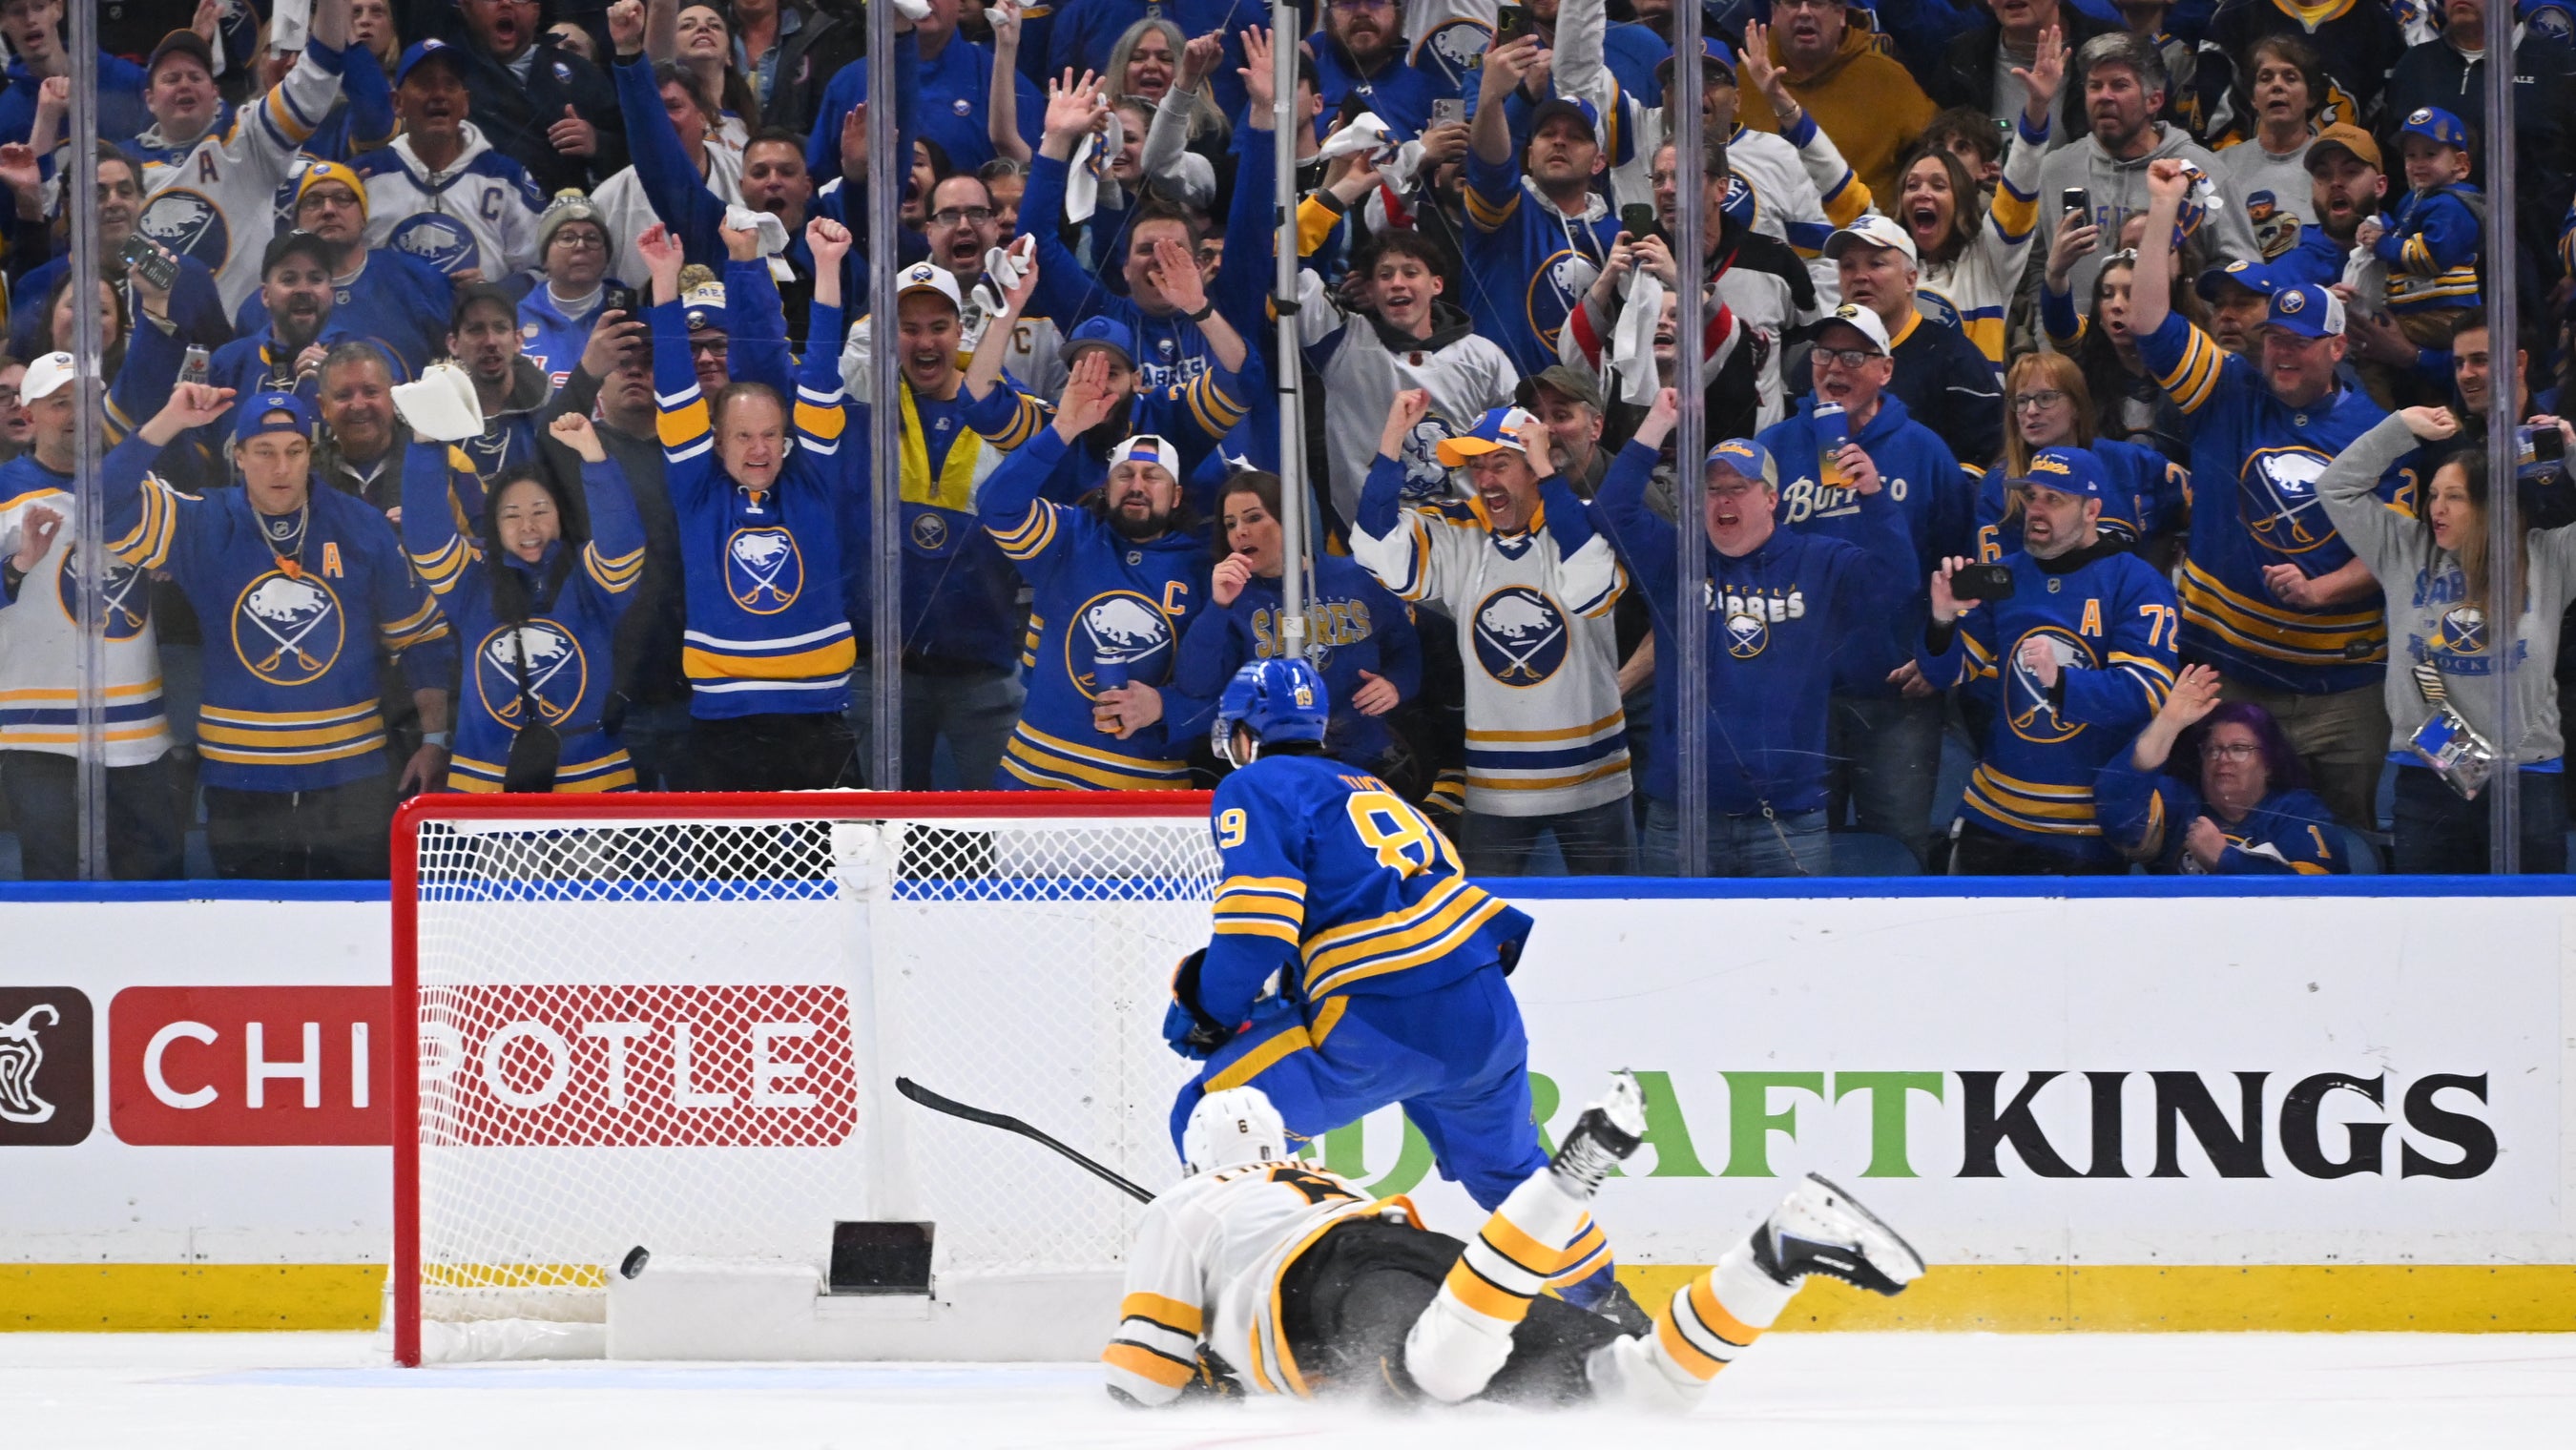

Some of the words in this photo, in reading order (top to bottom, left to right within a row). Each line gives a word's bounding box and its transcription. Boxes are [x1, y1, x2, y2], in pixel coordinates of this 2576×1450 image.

[199, 150, 218, 183] A
[480, 187, 502, 220] C
[1013, 327, 1031, 354] C
[1140, 357, 1207, 388] ABRES
[1782, 475, 1907, 525] BUFFO
[322, 542, 344, 578] A
[1163, 580, 1186, 615] C
[1251, 598, 1373, 659] SRES
[2081, 598, 2103, 638] A
[2139, 605, 2180, 652] 72
[1295, 689, 1313, 706] 89
[1215, 808, 1247, 849] 9
[2307, 824, 2332, 860] 1
[142, 1021, 819, 1109] CHIPOTLE
[1237, 1119, 1249, 1133] 6
